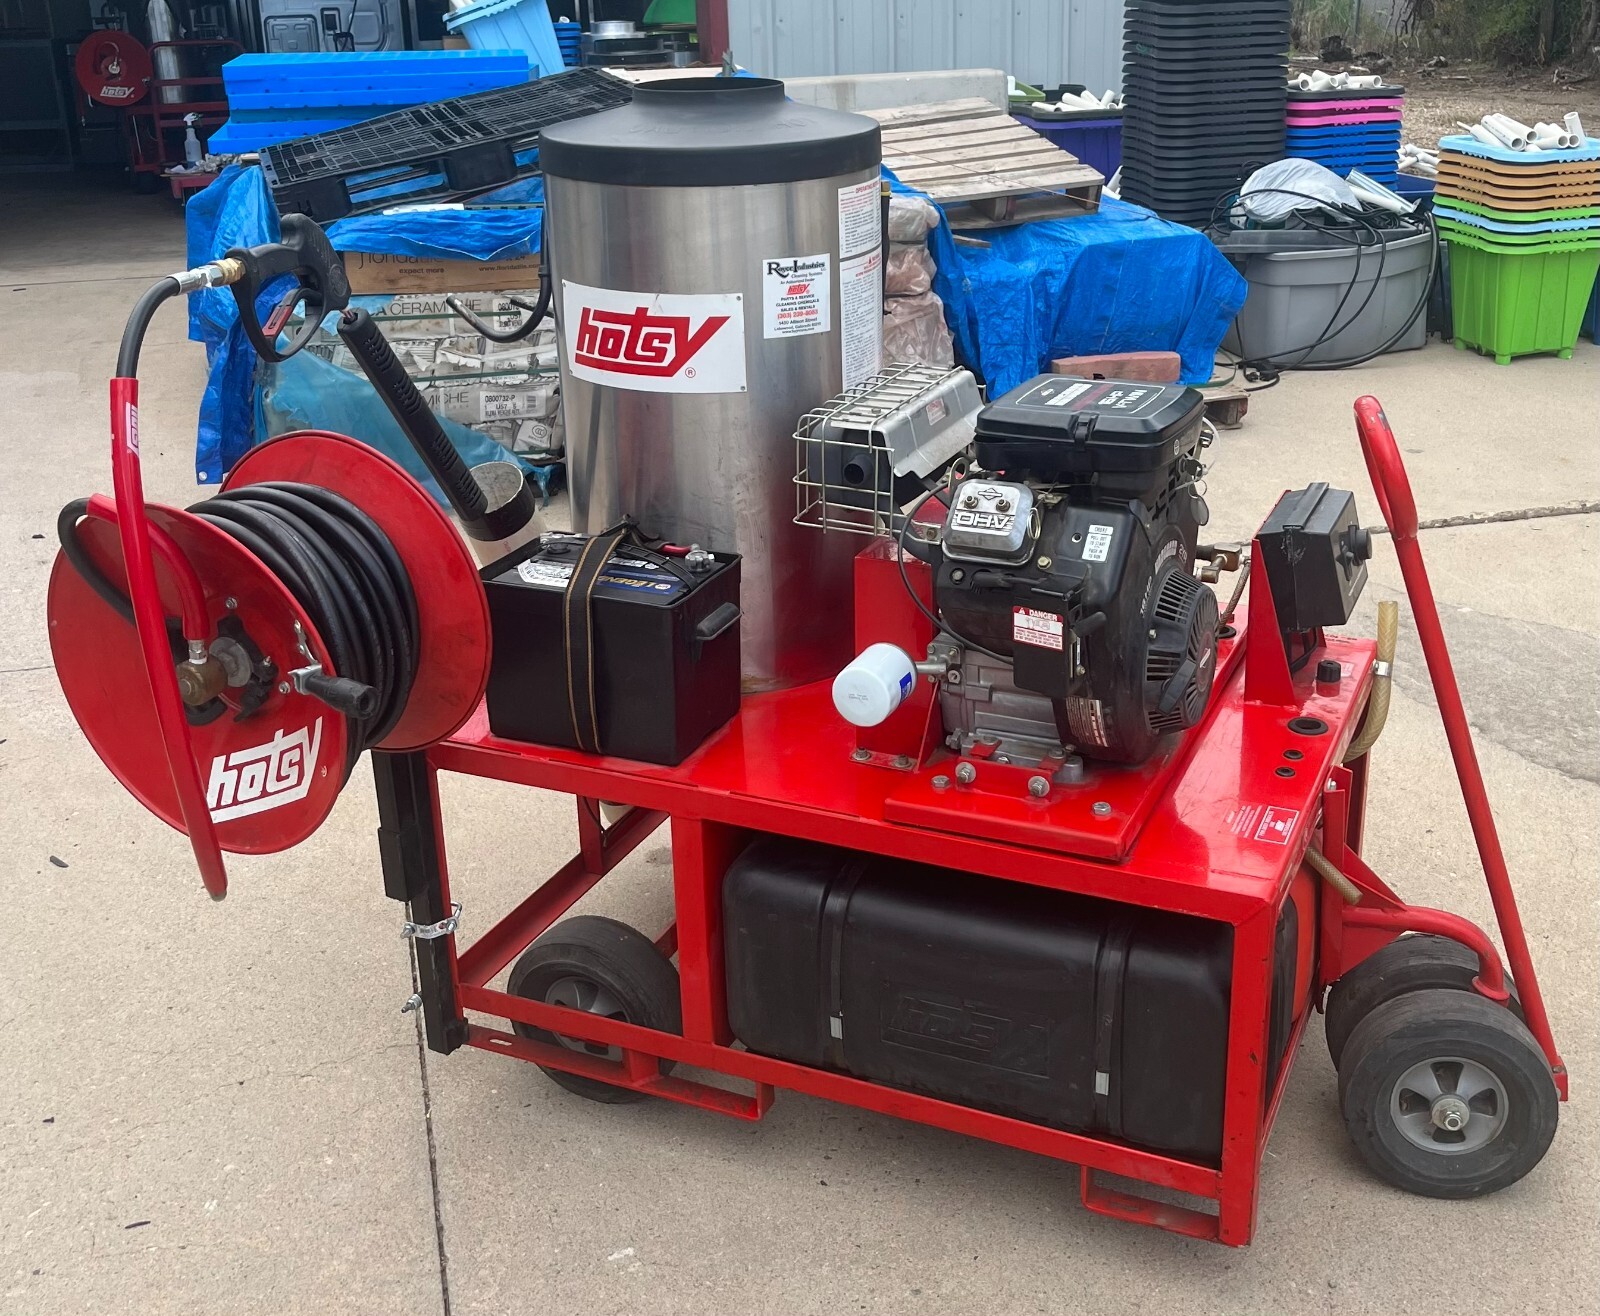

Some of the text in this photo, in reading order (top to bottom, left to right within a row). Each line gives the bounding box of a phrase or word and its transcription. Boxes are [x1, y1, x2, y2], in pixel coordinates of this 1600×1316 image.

[574, 306, 732, 377] hotsy
[956, 512, 1010, 530] OHV
[1029, 609, 1058, 622] DANGER
[206, 716, 322, 824] hotsy
